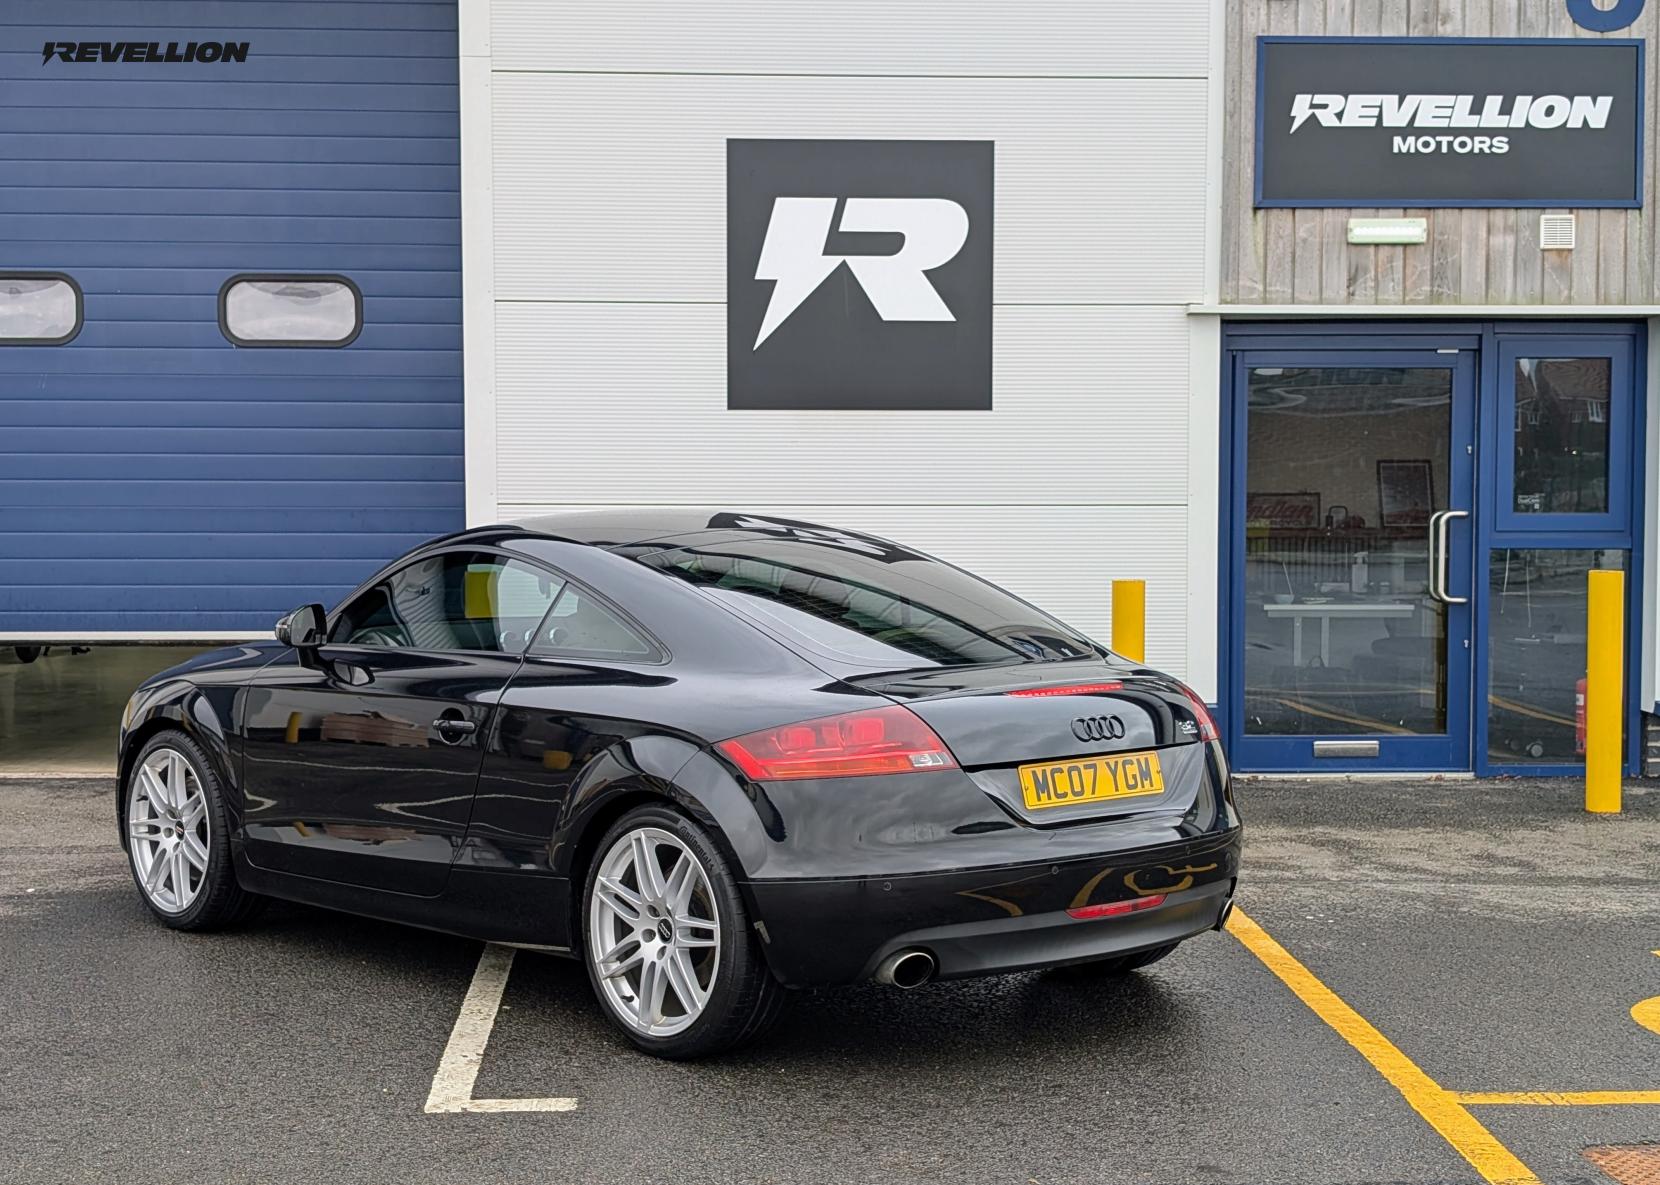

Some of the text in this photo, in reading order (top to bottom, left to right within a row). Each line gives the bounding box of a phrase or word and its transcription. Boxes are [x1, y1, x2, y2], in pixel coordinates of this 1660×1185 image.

[1290, 93, 1613, 134] REVELLION
[1392, 136, 1510, 154] MOTORS
[1032, 756, 1154, 802] MC07 YGM
[680, 826, 711, 865] Continental
